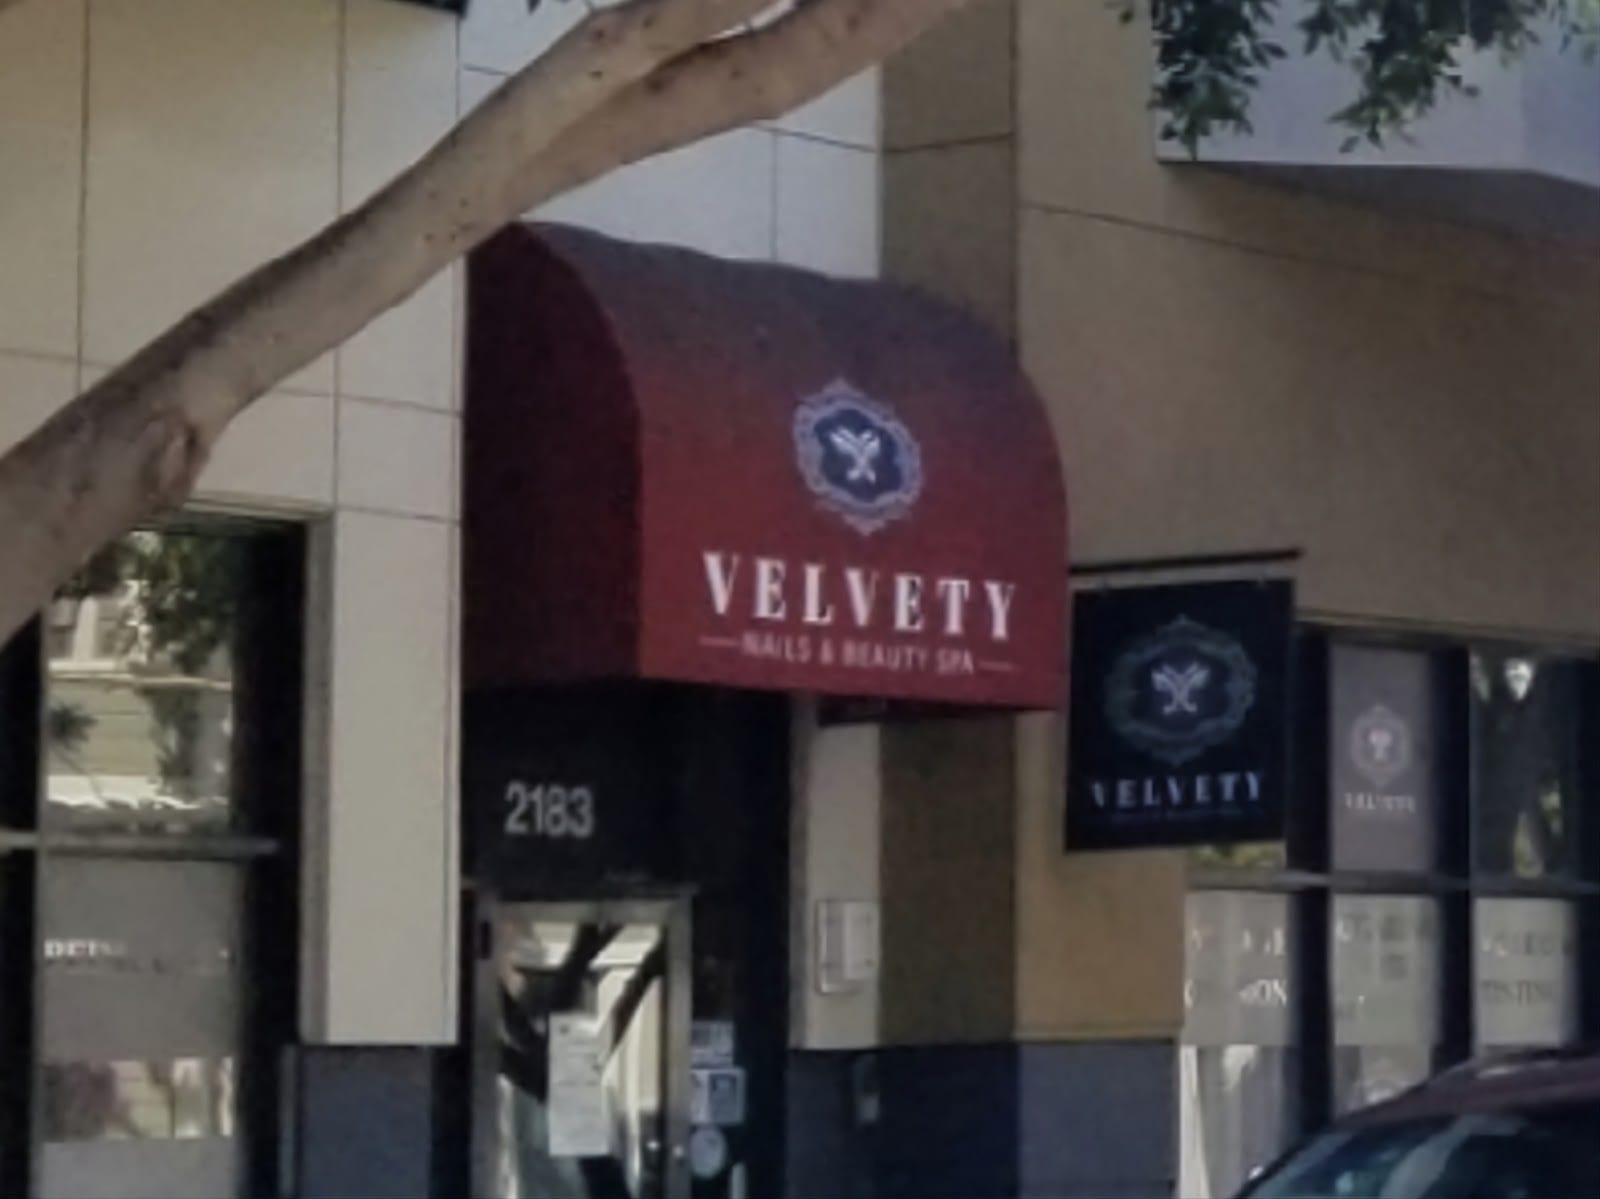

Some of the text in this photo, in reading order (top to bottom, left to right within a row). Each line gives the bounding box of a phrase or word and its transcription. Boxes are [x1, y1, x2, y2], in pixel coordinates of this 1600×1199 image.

[703, 551, 1016, 641] VELVETY
[741, 630, 811, 664] NAILS
[843, 639, 928, 672] BEAUTY
[935, 647, 975, 675] SPA
[504, 781, 594, 839] 2183
[1090, 770, 1264, 809] VELVETY
